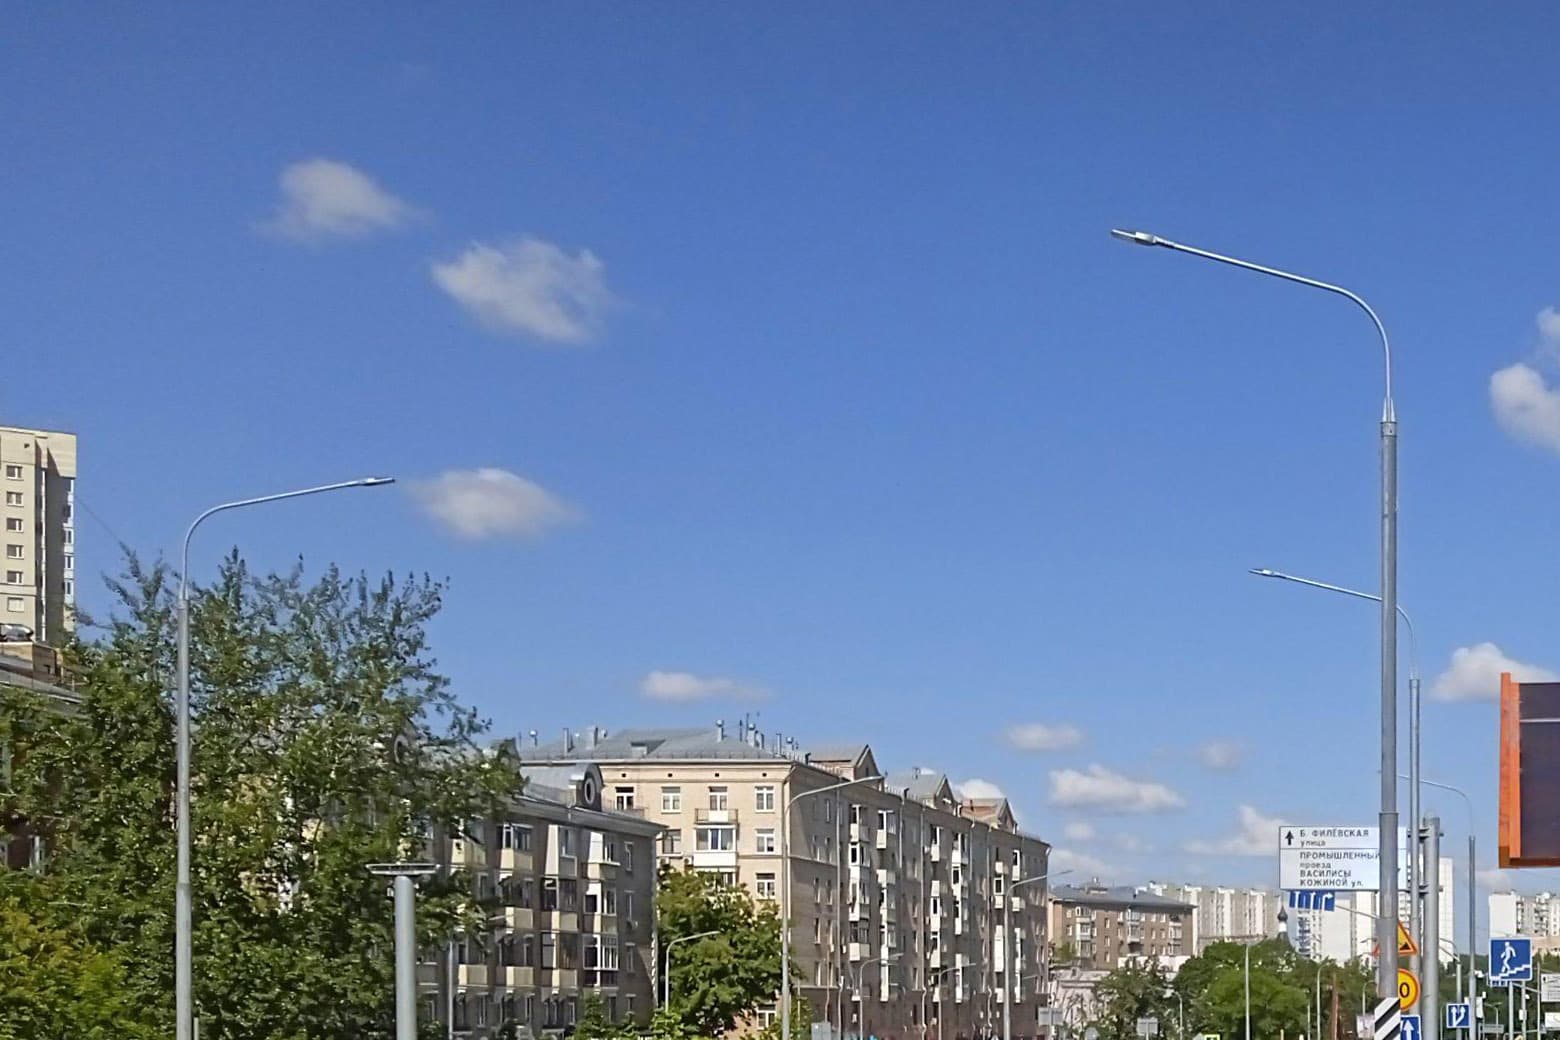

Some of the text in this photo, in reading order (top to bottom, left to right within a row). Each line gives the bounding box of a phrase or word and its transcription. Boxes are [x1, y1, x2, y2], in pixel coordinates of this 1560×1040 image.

[1300, 840, 1326, 848] улица
[1299, 862, 1332, 870] проезд
[1299, 869, 1352, 878] ВАСИЛИСЫ
[1299, 878, 1348, 887] КОЖИНОЙ
